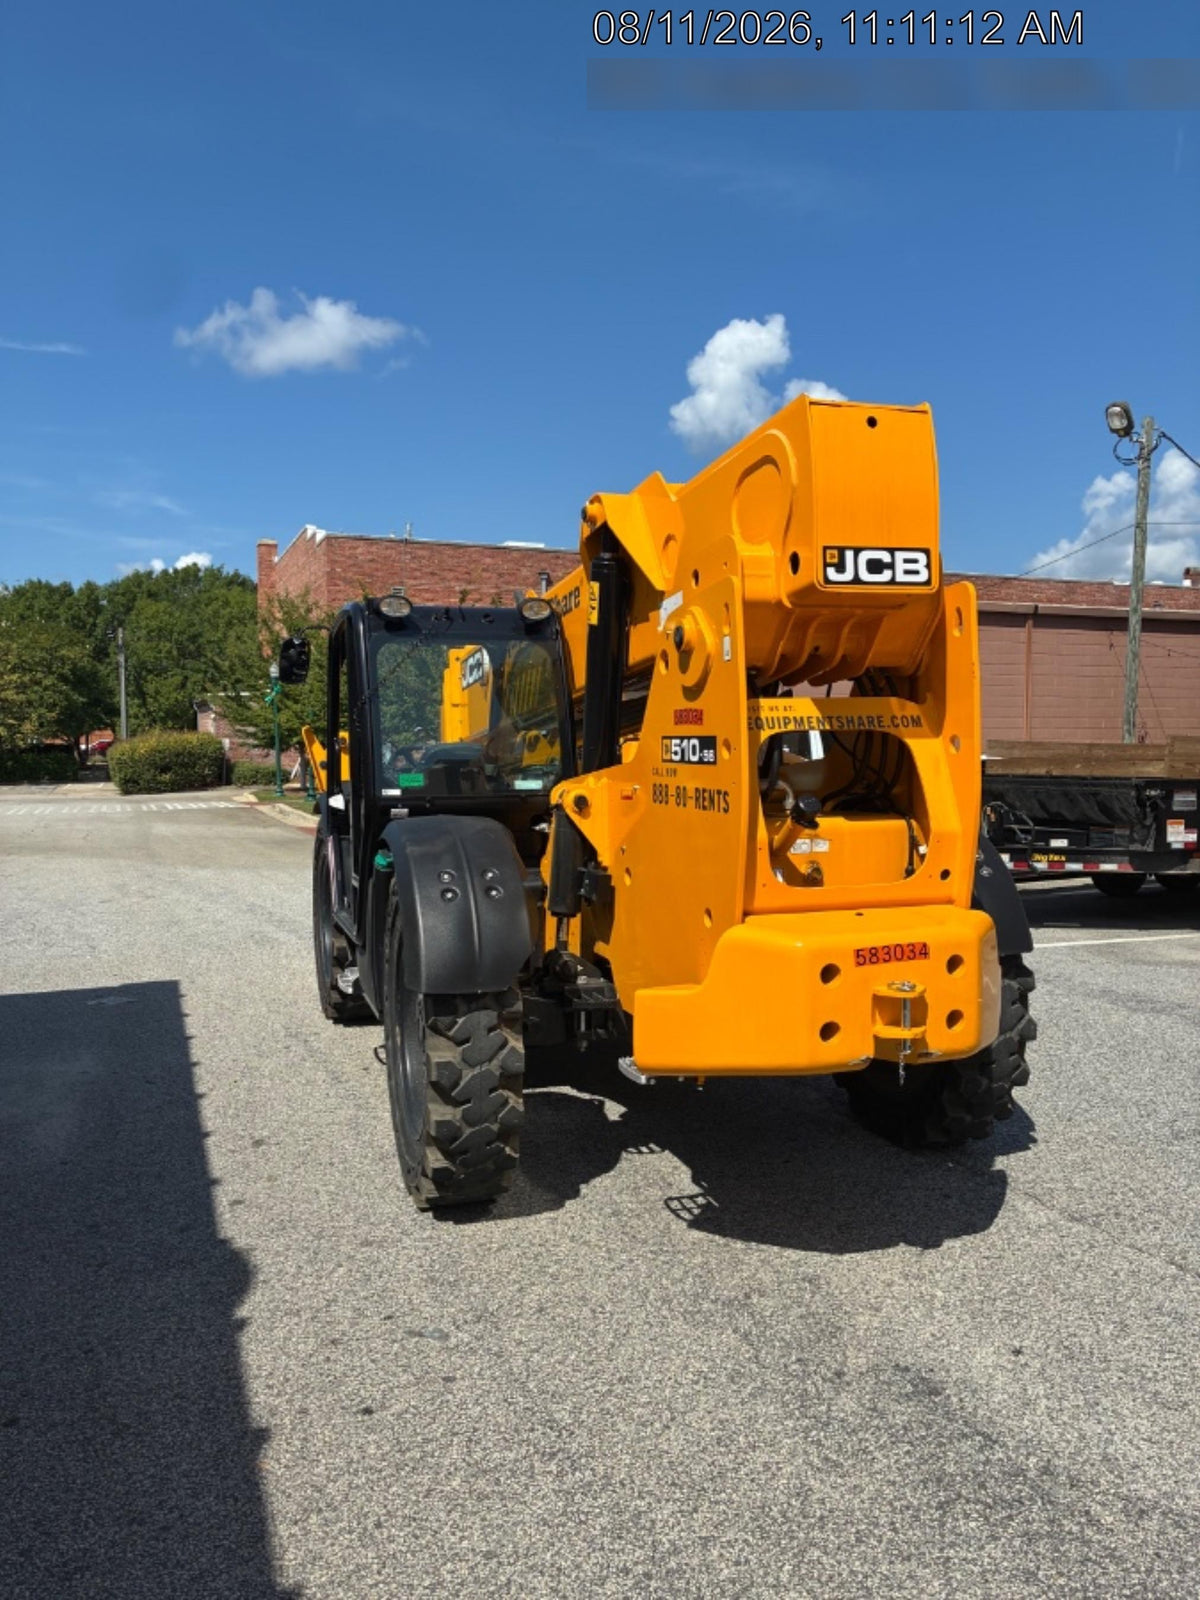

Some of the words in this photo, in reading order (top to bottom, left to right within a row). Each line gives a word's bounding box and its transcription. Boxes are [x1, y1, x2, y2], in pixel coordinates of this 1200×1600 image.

[826, 549, 929, 582] JCB
[748, 715, 923, 731] EQUIPMENTSHARE.COM
[855, 942, 929, 967] 583034
